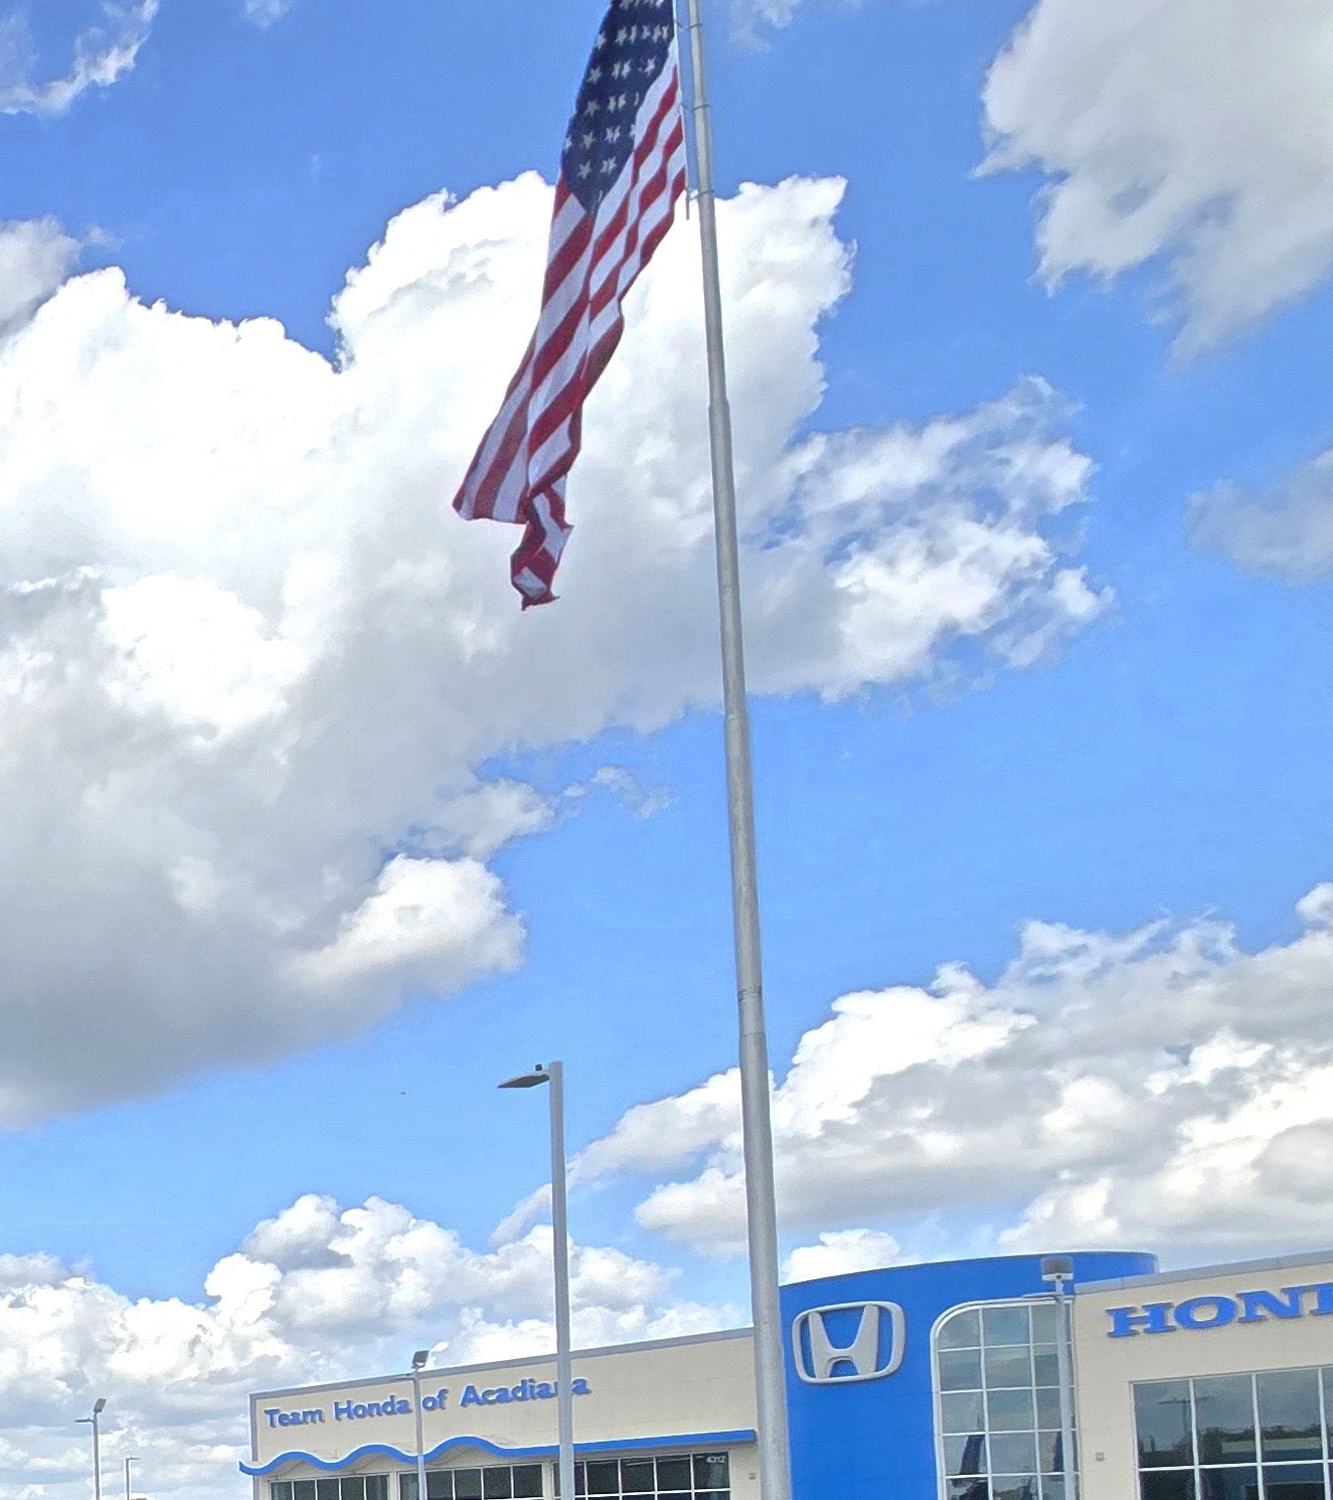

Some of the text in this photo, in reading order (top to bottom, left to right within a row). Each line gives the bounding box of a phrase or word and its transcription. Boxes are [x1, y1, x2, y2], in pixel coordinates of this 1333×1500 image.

[264, 1407, 326, 1428] Team
[333, 1395, 413, 1421] Honda
[422, 1388, 449, 1411] of
